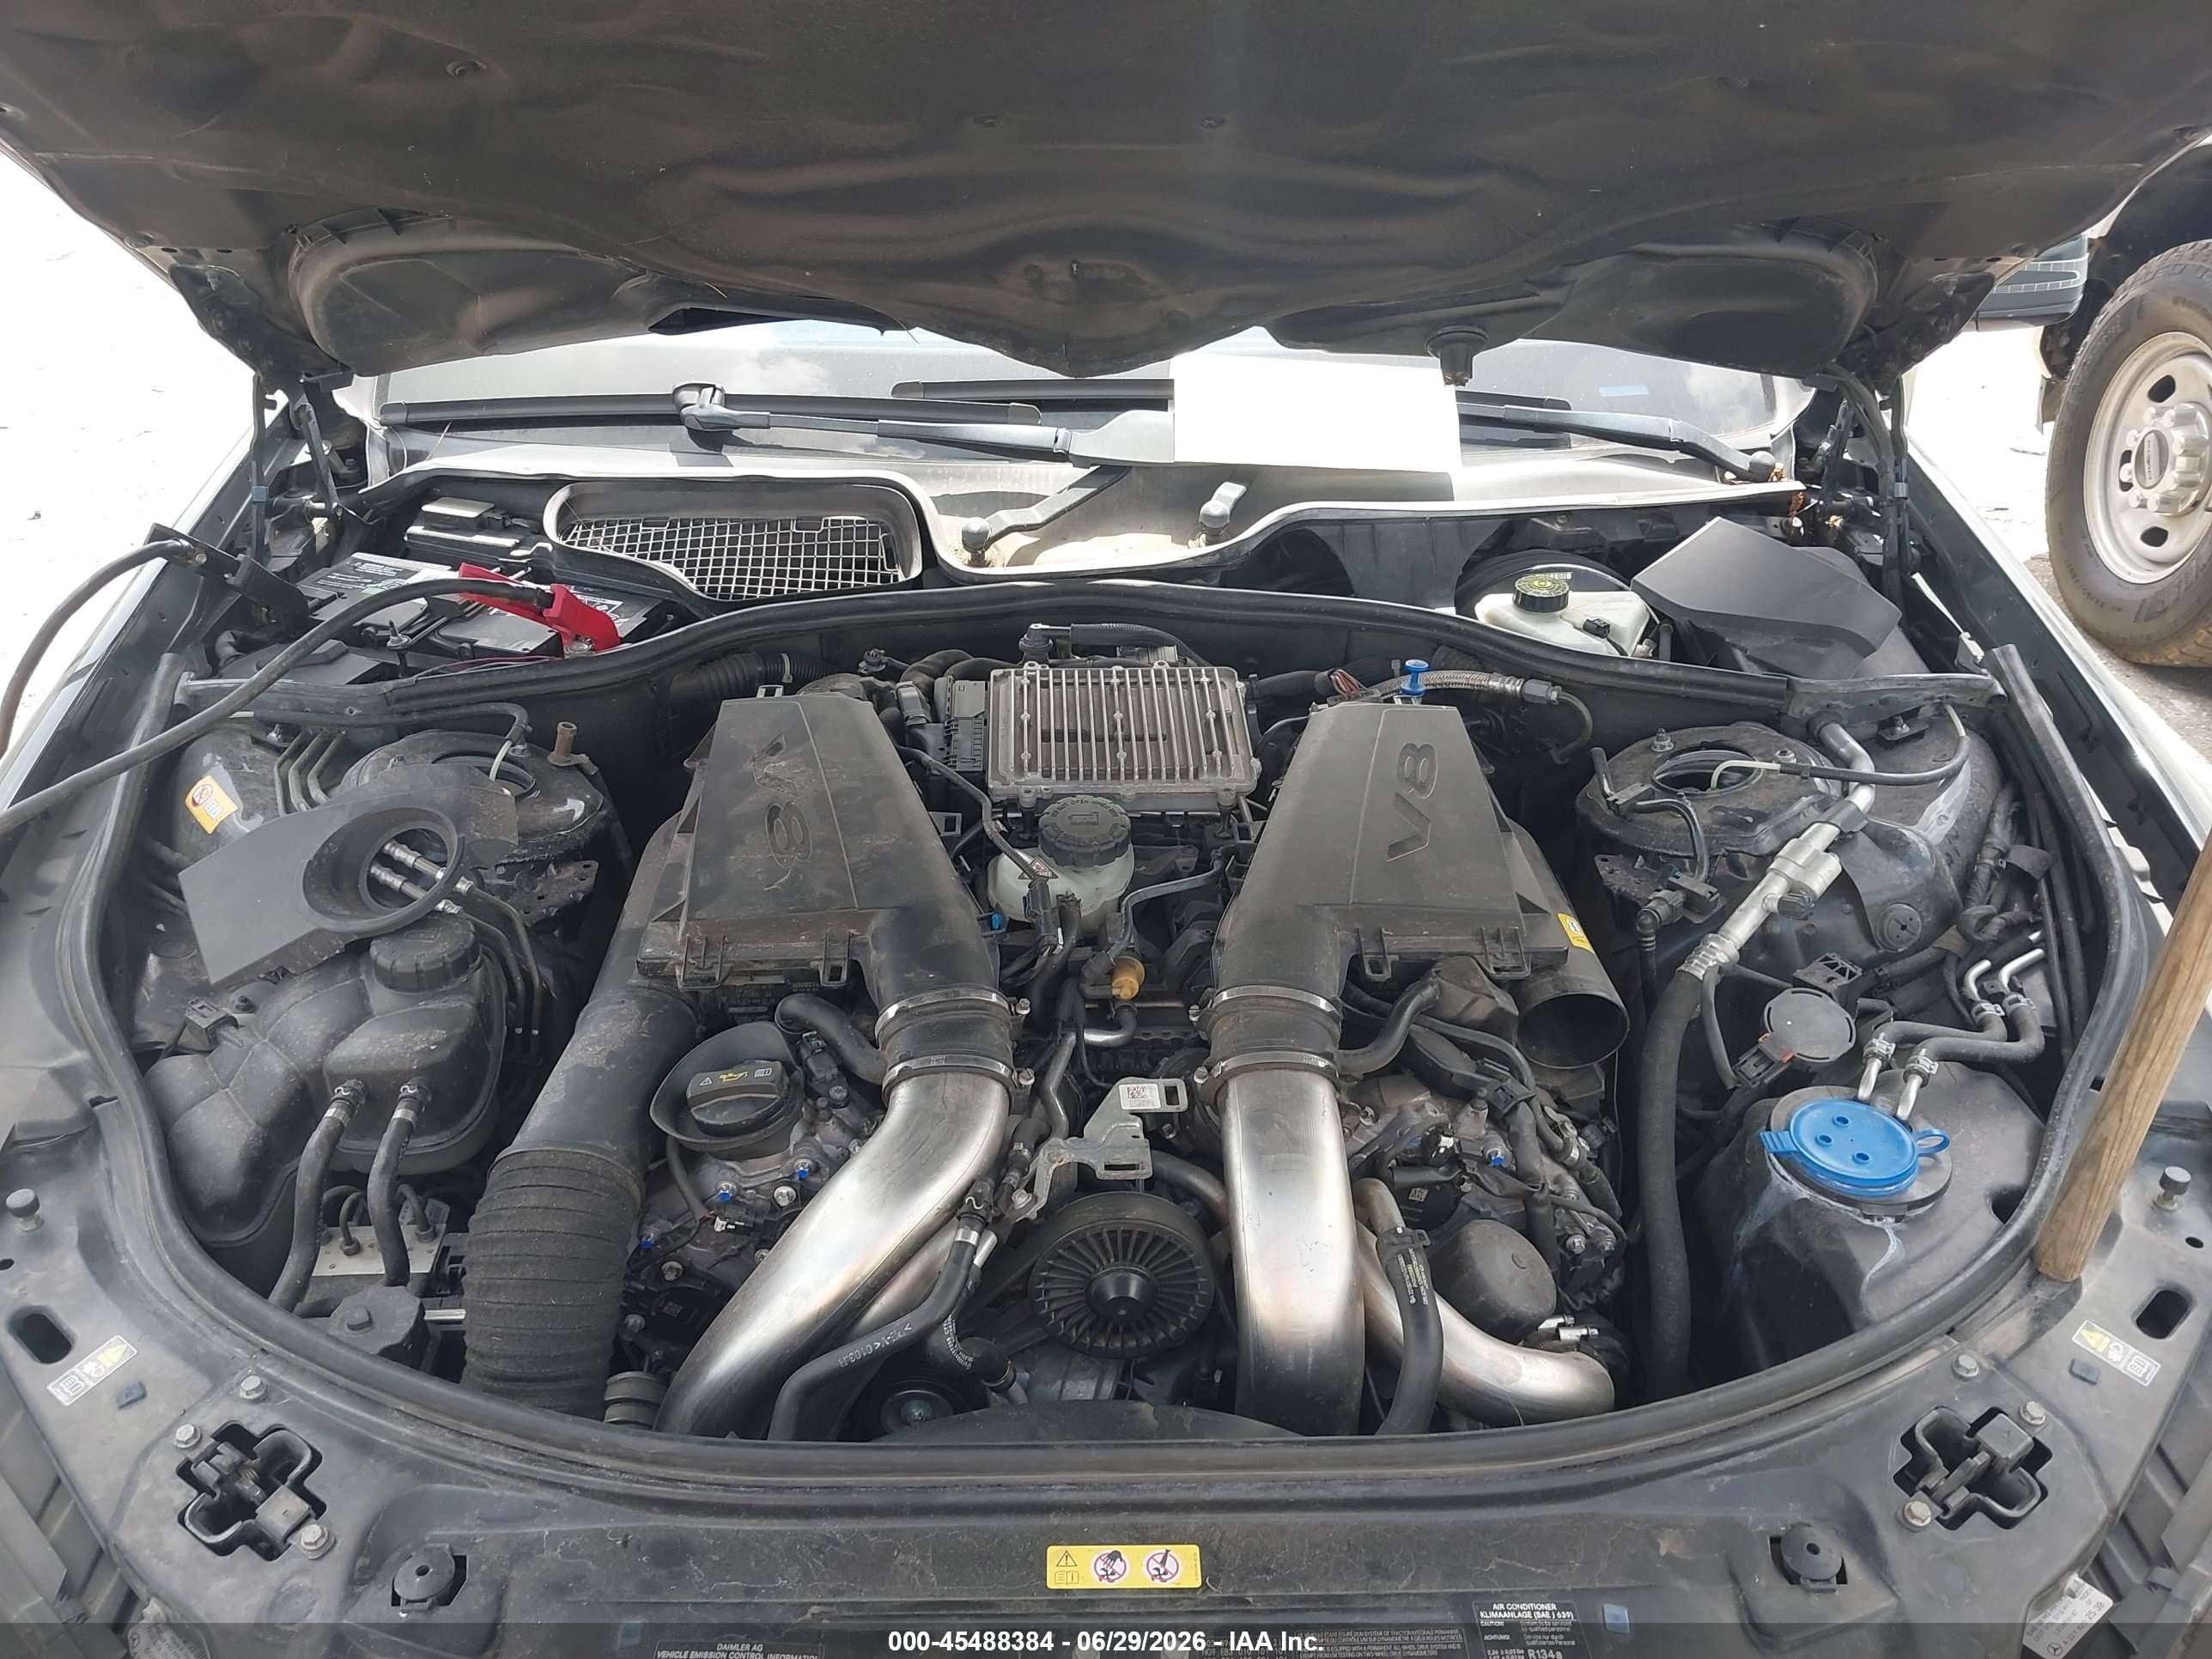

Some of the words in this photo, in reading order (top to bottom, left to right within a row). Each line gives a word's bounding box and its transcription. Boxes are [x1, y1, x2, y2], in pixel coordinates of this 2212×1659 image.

[752, 734, 812, 866] V8
[1387, 742, 1439, 862] V8
[1557, 1611, 1574, 1620] 639)
[716, 1643, 750, 1651] DAIMLER
[751, 1644, 763, 1652] AG
[657, 1650, 689, 1659] VEHICLE
[690, 1650, 727, 1659] EMISSION
[1528, 1649, 1563, 1659] R134a
